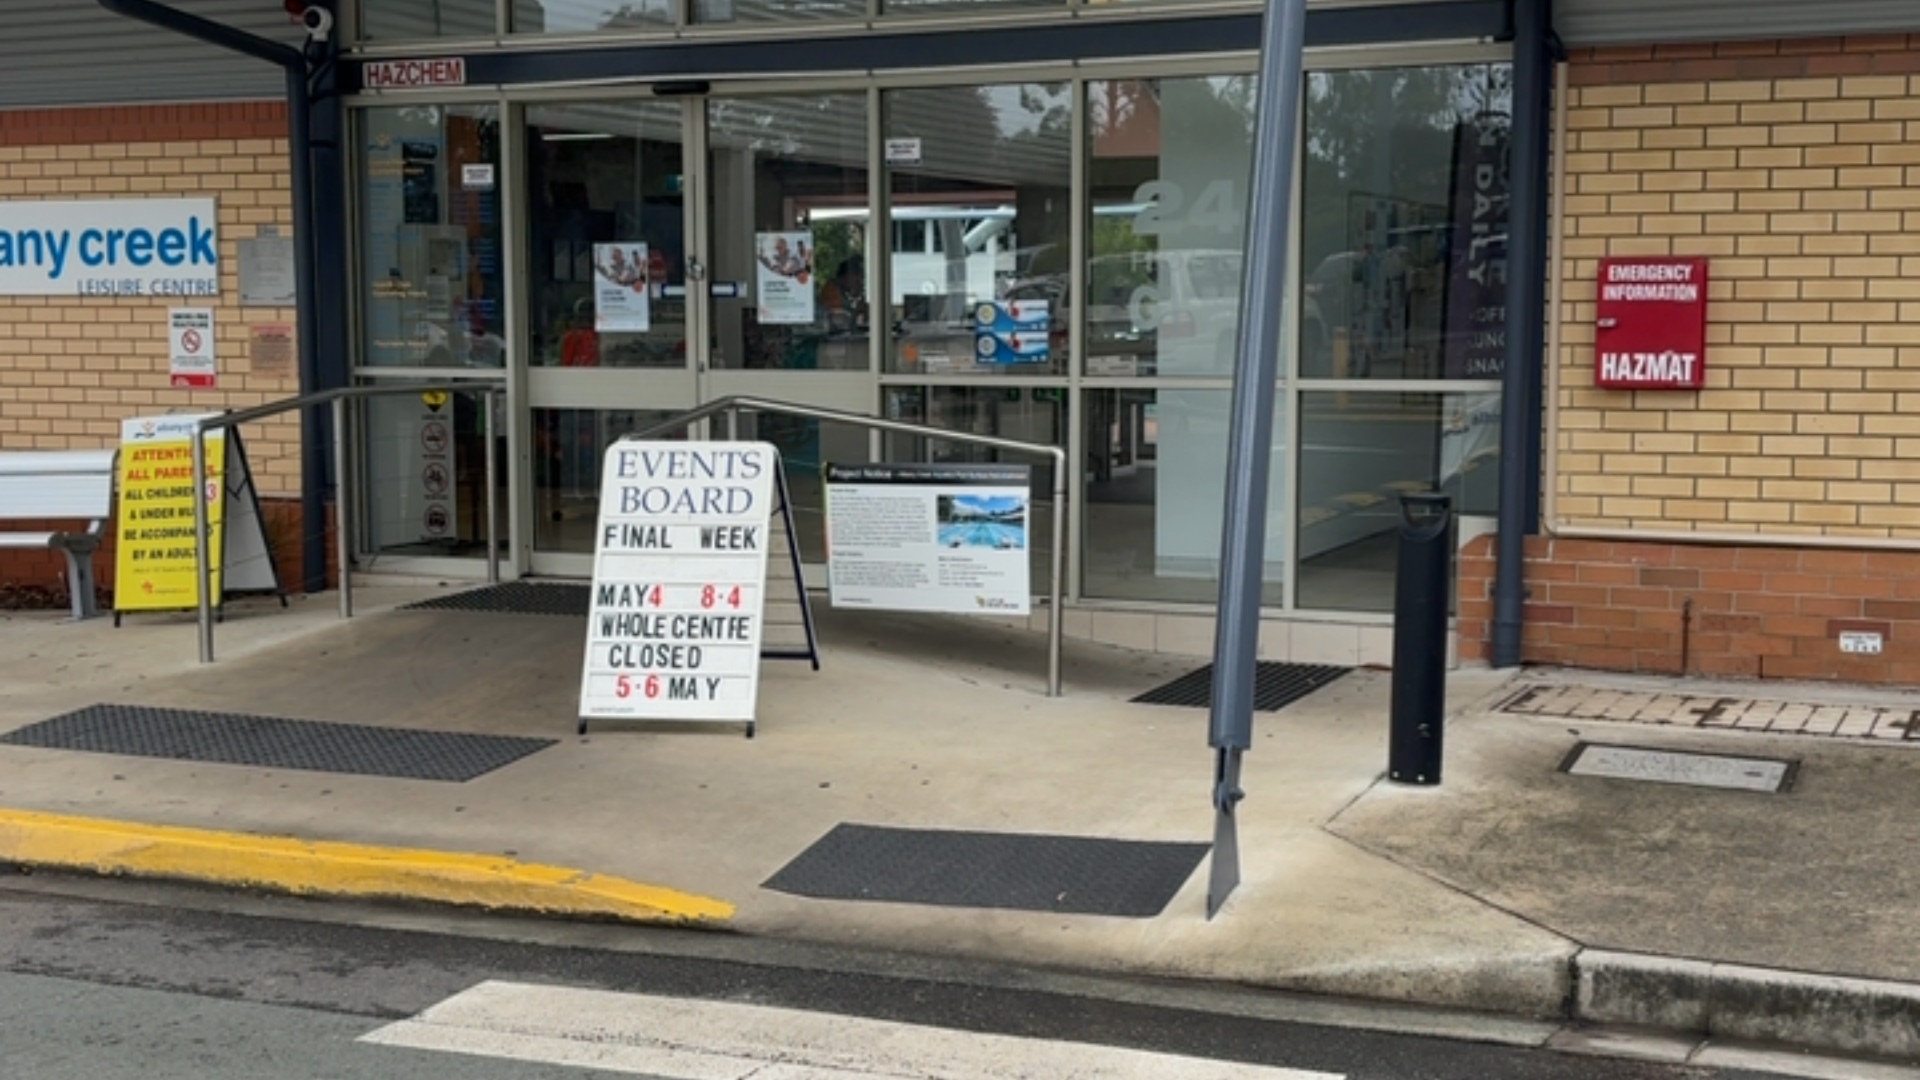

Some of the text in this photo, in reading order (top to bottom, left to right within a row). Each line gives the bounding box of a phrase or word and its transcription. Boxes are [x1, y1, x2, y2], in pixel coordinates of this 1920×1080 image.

[366, 60, 462, 85] HAZCHEM
[1133, 179, 1241, 234] 24
[1467, 164, 1495, 286] DAILY
[79, 215, 216, 266] creek
[1607, 264, 1693, 282] EMERGENCY
[77, 277, 217, 295] LEISURE CENTRE
[1602, 283, 1698, 302] INFORMATION
[1601, 351, 1697, 382] HAZMAT
[127, 468, 150, 480] ALL
[616, 449, 762, 480] EVENTS
[125, 487, 143, 500] ALL
[620, 486, 754, 515] BOARD
[139, 507, 174, 519] UNDER
[124, 529, 136, 541] BE
[602, 525, 757, 550] FINAL WEEK
[132, 549, 146, 561] BY
[149, 549, 163, 560] AN
[599, 613, 665, 639] WHOLE
[608, 643, 703, 669] CLOSED
[668, 676, 721, 701] MAY
